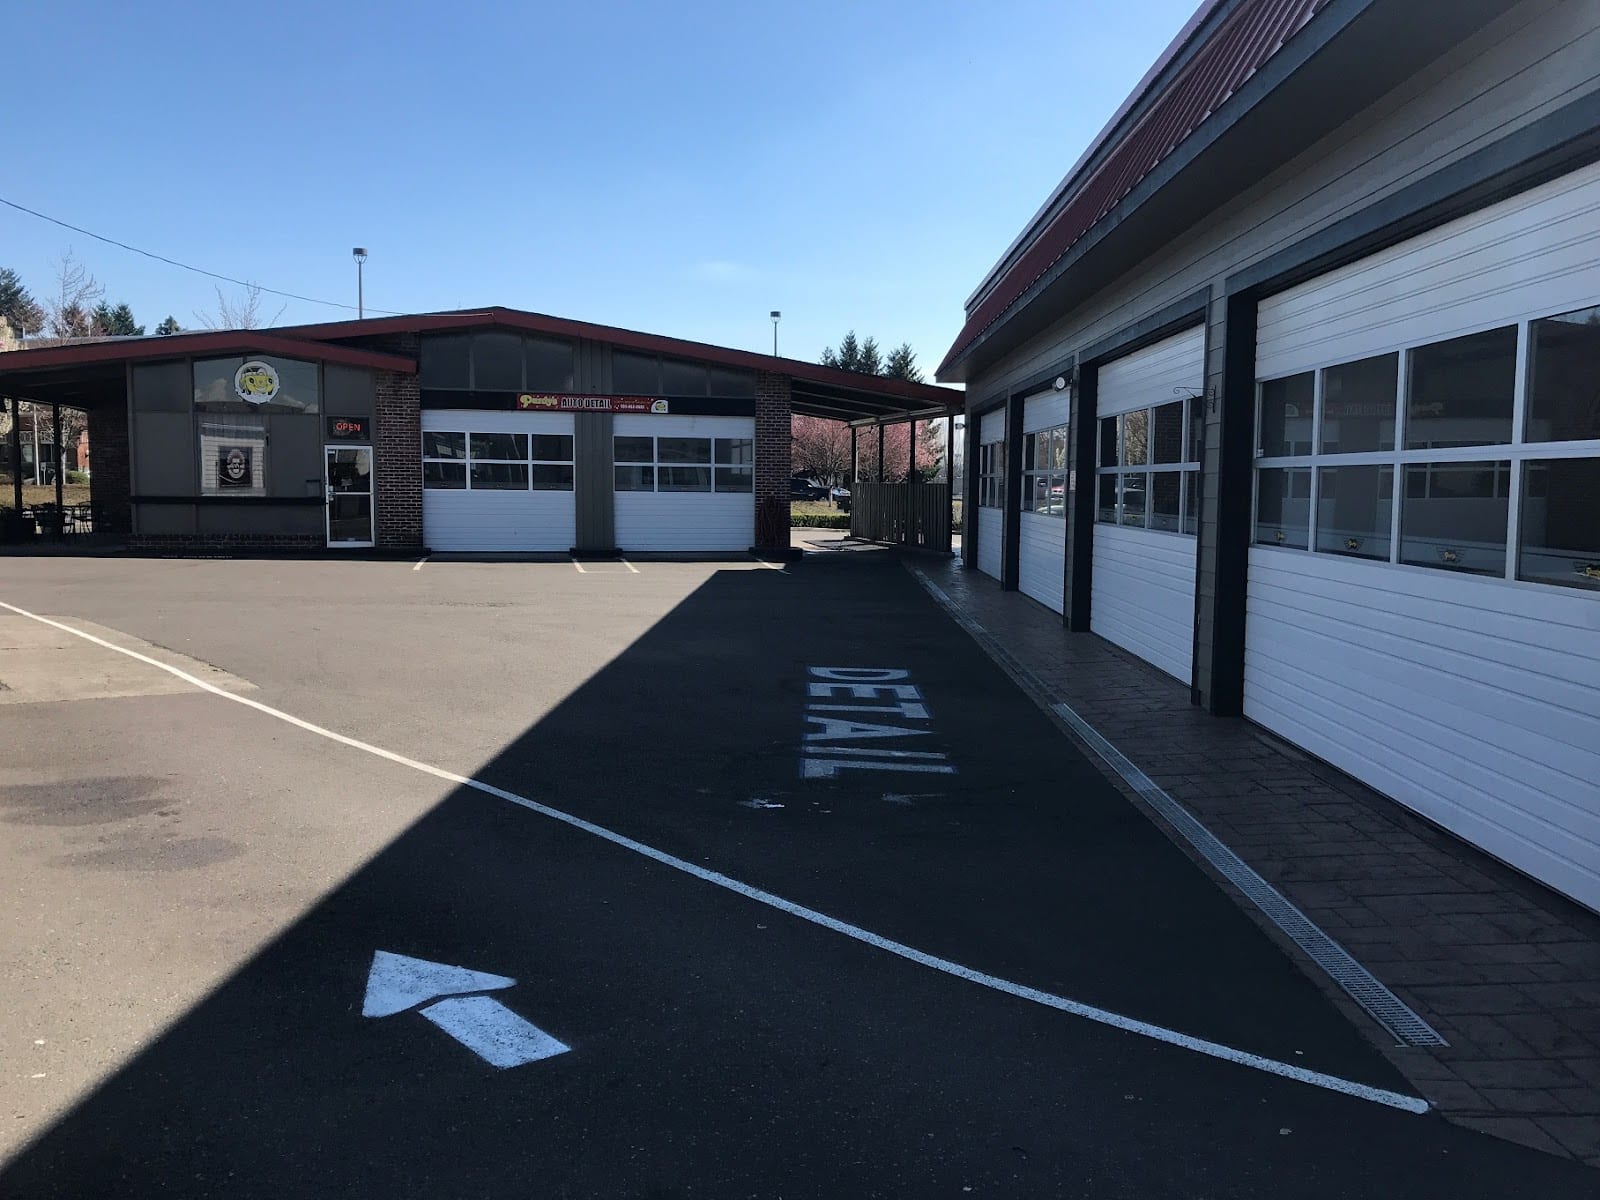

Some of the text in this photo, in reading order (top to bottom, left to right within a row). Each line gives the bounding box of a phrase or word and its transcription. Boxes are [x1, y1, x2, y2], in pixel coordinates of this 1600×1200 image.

[560, 397, 584, 409] AUTO
[584, 398, 612, 410] DETAIL
[336, 422, 361, 432] OPEN
[804, 666, 955, 778] DETAIL
